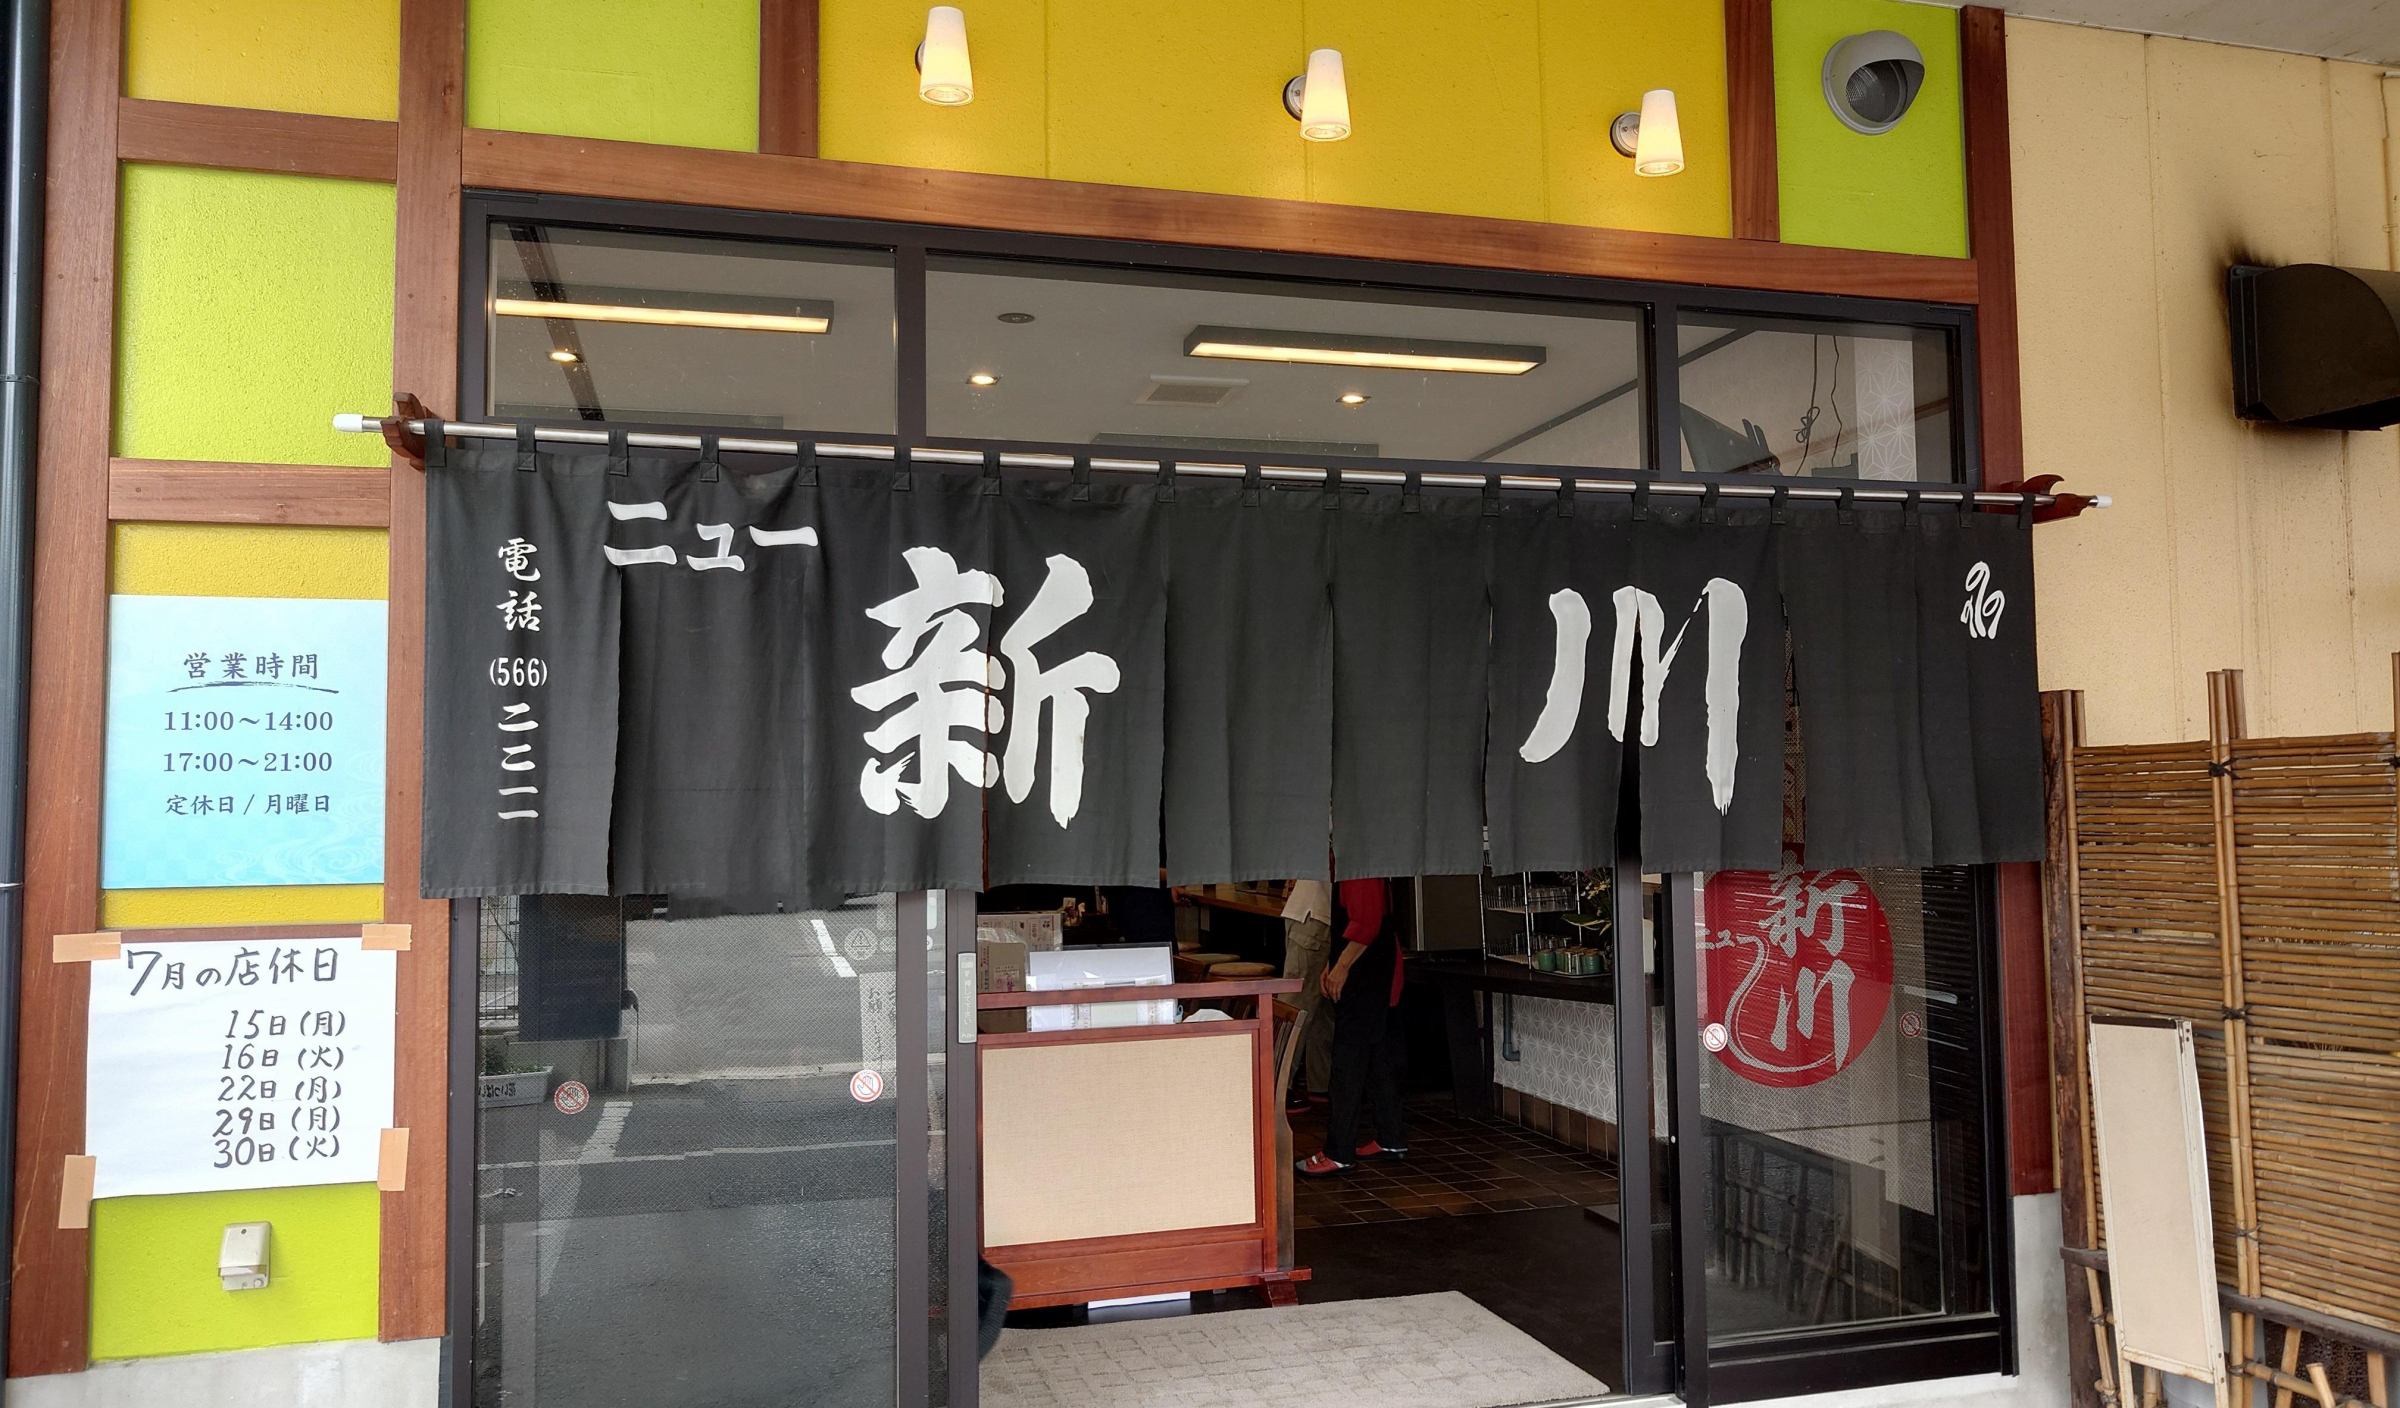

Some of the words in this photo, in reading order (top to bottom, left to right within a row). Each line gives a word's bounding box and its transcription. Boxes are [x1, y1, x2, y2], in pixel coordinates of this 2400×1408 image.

[604, 501, 819, 572] ニュー
[184, 652, 319, 679] 営業時間
[127, 946, 339, 996] 7月の店休日
